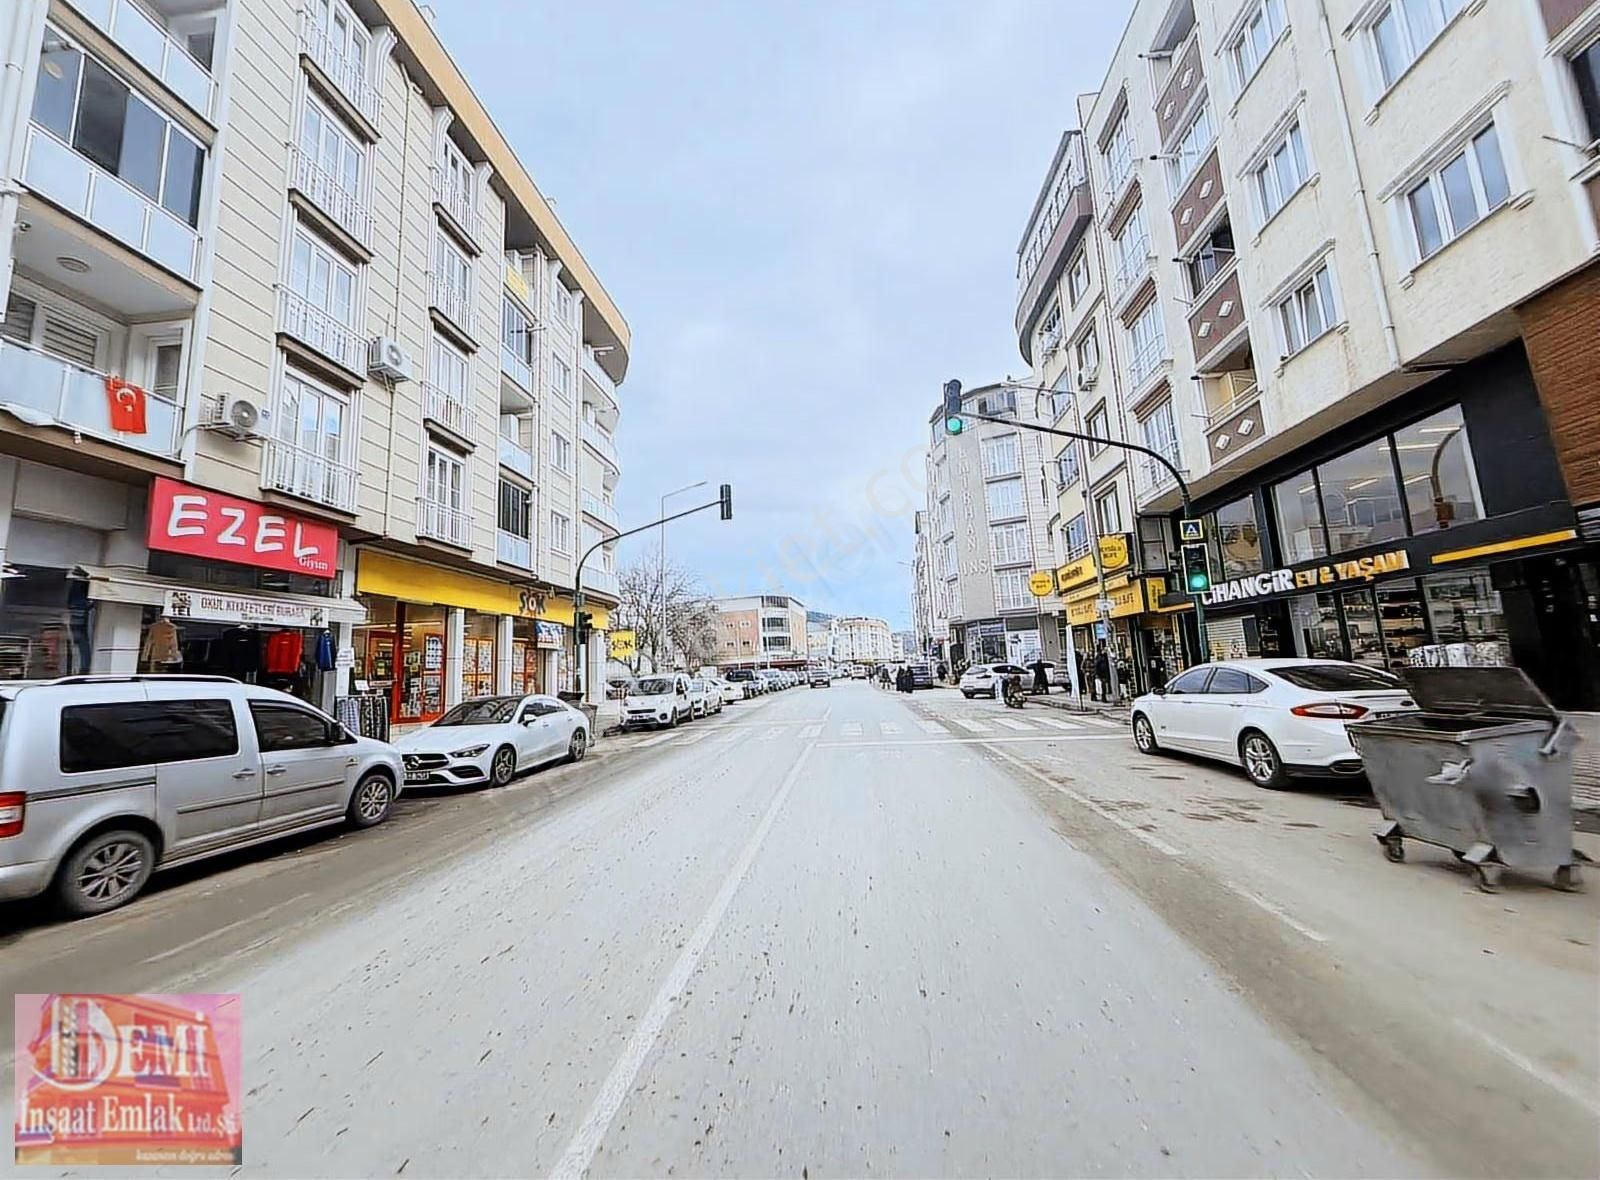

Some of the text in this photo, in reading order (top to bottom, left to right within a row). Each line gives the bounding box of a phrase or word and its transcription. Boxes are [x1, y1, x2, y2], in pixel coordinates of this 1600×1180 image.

[167, 494, 319, 558] EZEL
[299, 557, 329, 572] Giyim
[1295, 568, 1318, 588] EV
[1319, 566, 1336, 584] &
[1333, 549, 1410, 581] YAŞAM
[201, 597, 224, 611] OKUL
